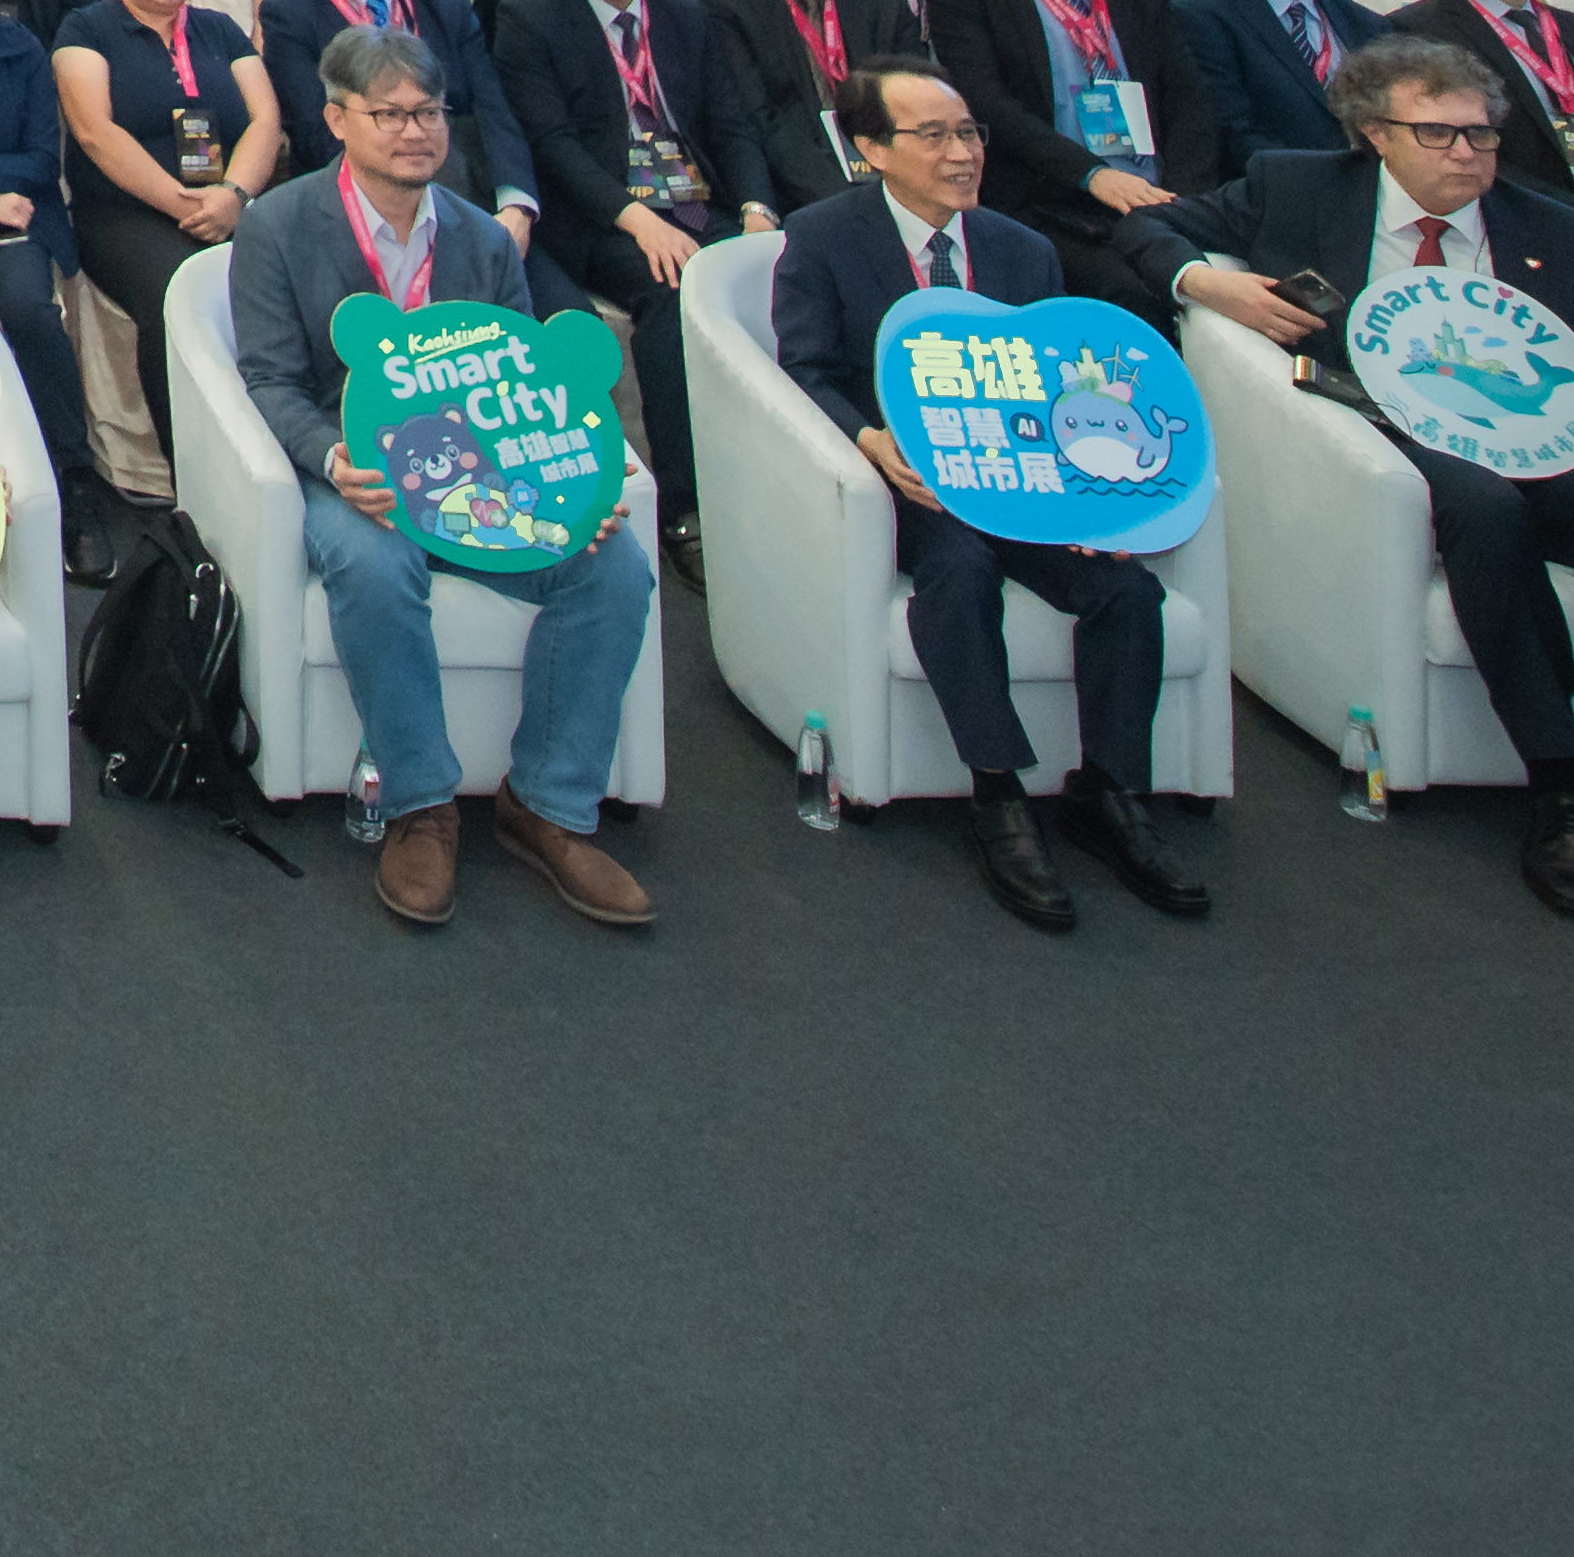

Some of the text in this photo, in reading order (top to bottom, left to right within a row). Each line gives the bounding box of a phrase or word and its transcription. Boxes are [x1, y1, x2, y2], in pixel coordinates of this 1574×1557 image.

[1088, 133, 1117, 145] VIP
[1354, 275, 1560, 355] Smart City
[407, 321, 507, 355] Kaohsiung
[382, 336, 536, 400] Smart
[902, 330, 1048, 401] 高雄
[465, 380, 568, 431] City
[920, 405, 1012, 449] 智慧
[493, 428, 590, 470] 高雄智慧
[1017, 418, 1038, 439] AI
[539, 452, 600, 484] 城市展
[932, 448, 1066, 494] 城市展
